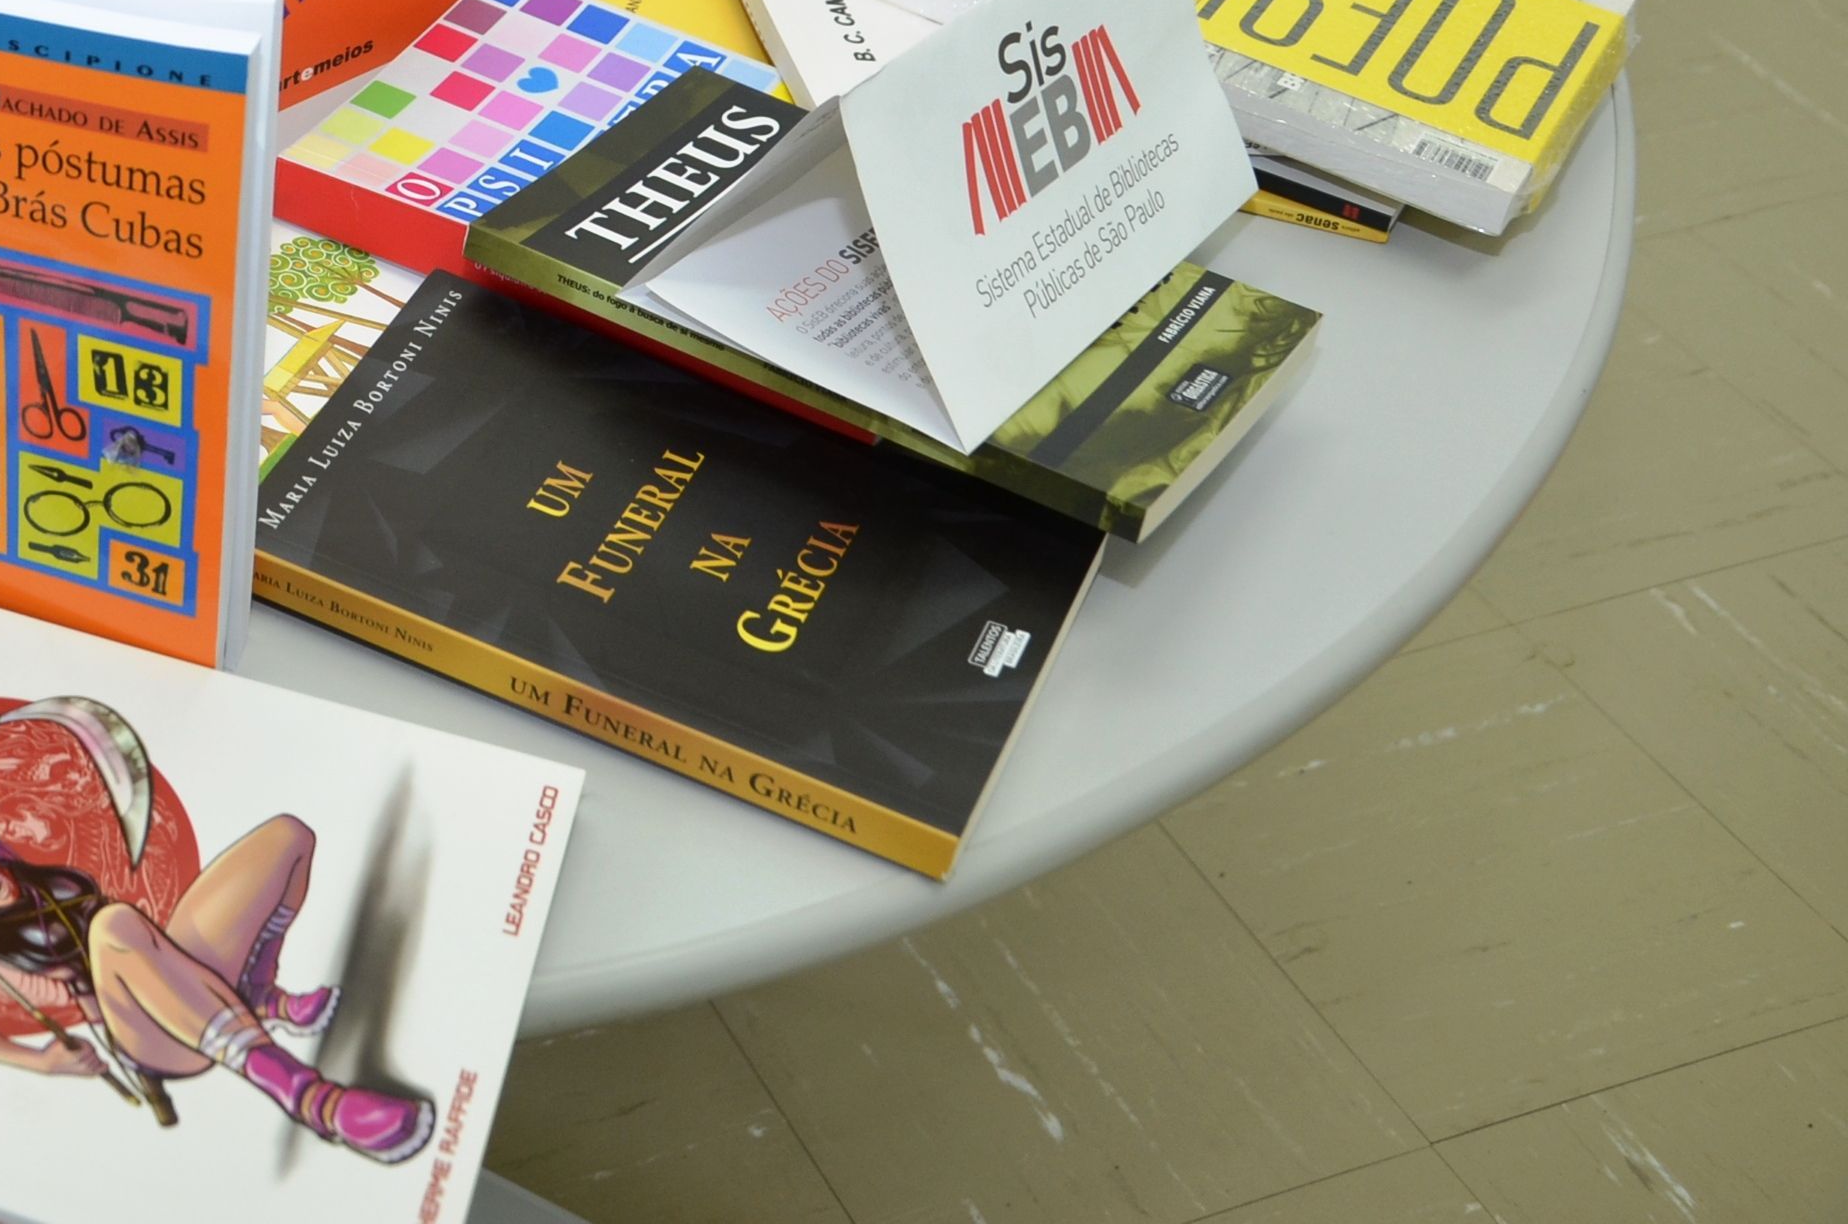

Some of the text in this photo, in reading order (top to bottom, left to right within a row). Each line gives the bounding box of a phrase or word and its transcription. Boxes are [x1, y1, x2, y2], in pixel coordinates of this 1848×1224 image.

[7, 38, 214, 87] SCIPIONE
[843, 30, 866, 45] C.
[853, 48, 877, 62] B.
[998, 20, 1067, 104] Sis
[99, 113, 126, 134] DE
[136, 120, 201, 150] ASSIS
[1009, 73, 1092, 199] EB
[15, 138, 207, 206] póstumas
[395, 177, 440, 201] O
[565, 105, 781, 253] THEUS
[80, 201, 205, 260] Cubas
[976, 130, 1181, 309] Sistema Estadual de Bibliotecas
[1295, 212, 1340, 231] senac
[1023, 256, 1085, 319] Públicas
[1084, 241, 1102, 264] de
[1100, 218, 1128, 251] São
[1125, 187, 1166, 231] Paulo
[557, 274, 689, 335] THEUS: do fogo busca de si
[766, 258, 849, 323] AÇÕES DO
[844, 289, 882, 323] bibliotecas
[1157, 308, 1192, 344] FABRÍCIO
[1189, 286, 1217, 310] VIANA
[259, 289, 463, 530] MARIA LUIZA BORTONI NINIS
[526, 460, 594, 518] UM
[556, 448, 706, 604] FUNERAL
[121, 550, 170, 596] 31
[689, 532, 752, 583] NA
[736, 520, 861, 653] GRÉCIA
[286, 582, 434, 653] LUIZA BORTONI NINIS
[974, 625, 1002, 663] TALENTOS
[509, 677, 858, 834] UM FUNERAL NA GRÉCIA
[503, 786, 559, 937] LEANDRO CASCO
